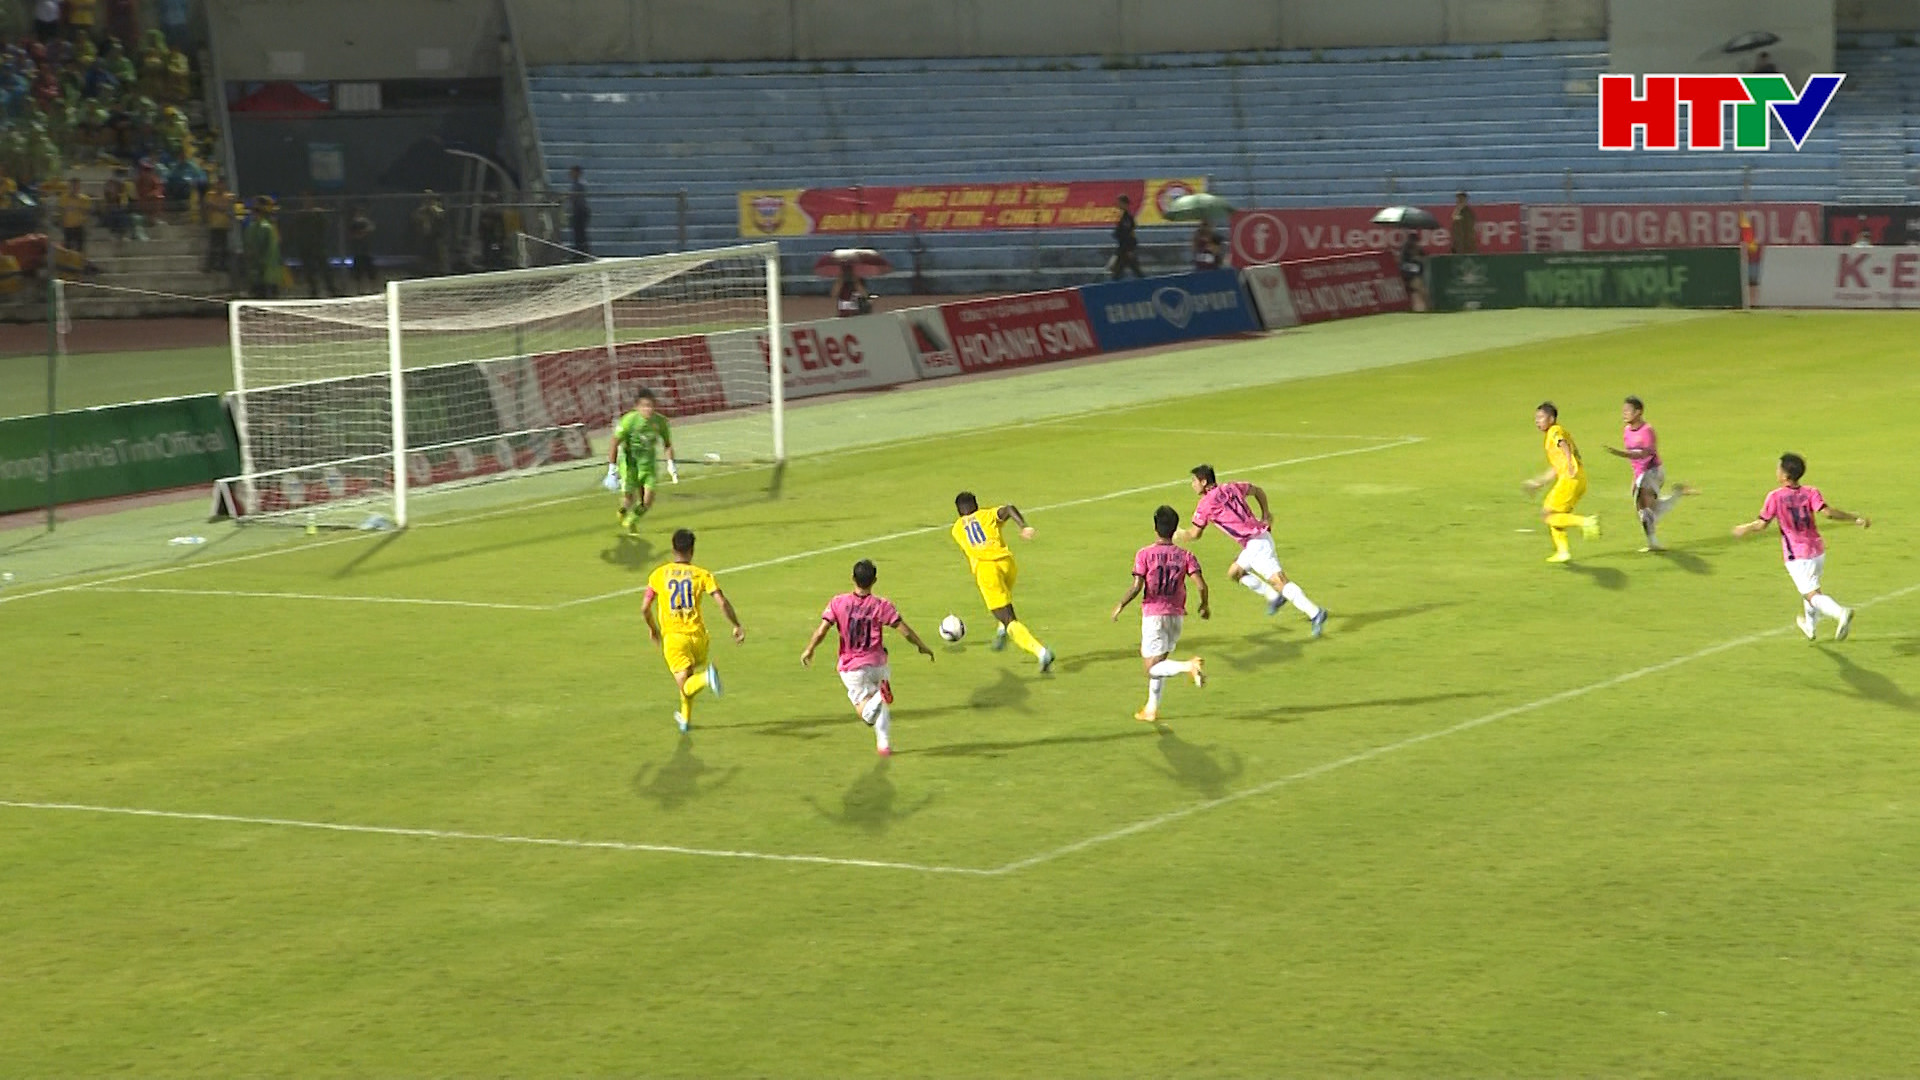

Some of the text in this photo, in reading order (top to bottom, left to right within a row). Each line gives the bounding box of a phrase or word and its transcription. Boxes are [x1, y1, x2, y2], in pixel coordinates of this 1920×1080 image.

[1587, 209, 1817, 246] JOGARBOLA
[955, 323, 1044, 366] HOÀNH
[964, 520, 987, 546] 10
[668, 578, 694, 610] 20
